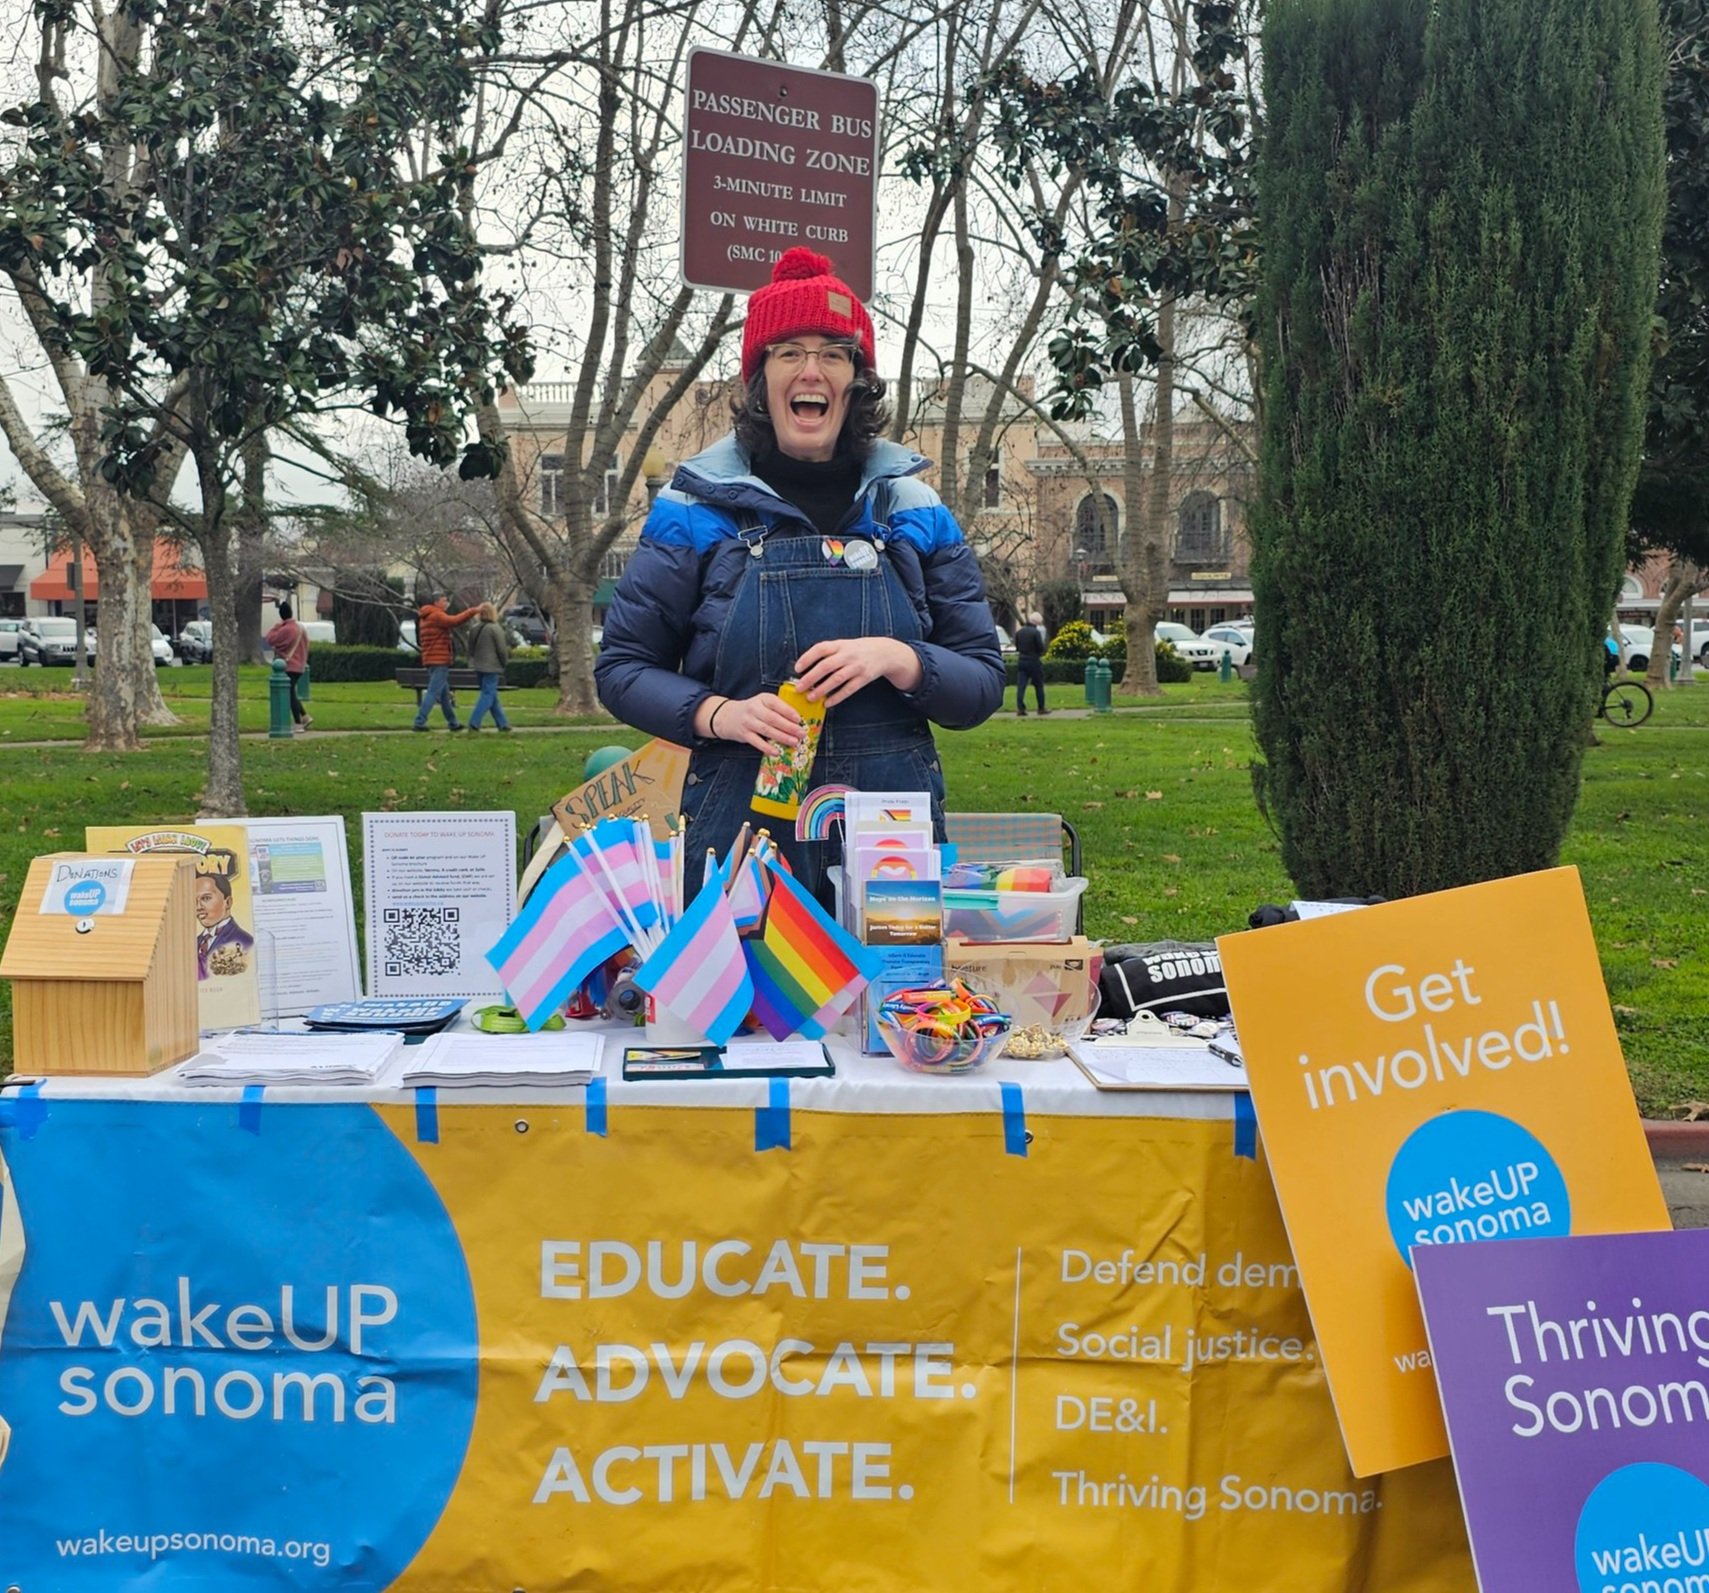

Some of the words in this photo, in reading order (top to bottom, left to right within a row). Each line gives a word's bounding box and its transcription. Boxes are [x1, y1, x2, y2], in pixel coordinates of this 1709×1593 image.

[692, 89, 821, 131] PASSENGER
[831, 114, 872, 138] BUS
[691, 129, 796, 165] LOADING
[806, 149, 870, 176] ZONE
[713, 175, 793, 200] 3-MINUTE
[800, 188, 847, 207] LIMIT
[710, 211, 736, 228] ON
[743, 215, 799, 237] WHITE
[805, 224, 849, 243] CURB
[727, 243, 765, 262] (SMC
[769, 249, 783, 263] 10
[565, 760, 655, 829] SPEAK
[196, 854, 231, 875] ORY
[1147, 955, 1221, 983] sonom
[1364, 959, 1482, 1023] Get
[1297, 999, 1570, 1110] involved!
[1402, 1161, 1540, 1222] wakeUP
[1414, 1201, 1551, 1245] sonoma
[540, 1239, 911, 1300] EDUCATE.
[1061, 1249, 1207, 1287] Defend
[1217, 1251, 1303, 1288] dem
[48, 1276, 399, 1355] wakeUP
[1486, 1297, 1709, 1368] Thriving
[532, 1339, 977, 1402] ADVOCATE.
[1056, 1322, 1172, 1360] Social
[1181, 1328, 1314, 1373] justice.
[1393, 1350, 1433, 1374] wa
[57, 1365, 397, 1424] sonoma
[1055, 1394, 1168, 1435] DE&I.
[1504, 1374, 1709, 1438] Sonom
[531, 1438, 914, 1505] ACTIVATE.
[1052, 1470, 1207, 1521] Thriving
[1219, 1475, 1384, 1515] Sonoma.
[55, 1529, 331, 1568] wakeupsonoma.org
[1591, 1528, 1709, 1576] wakeU
